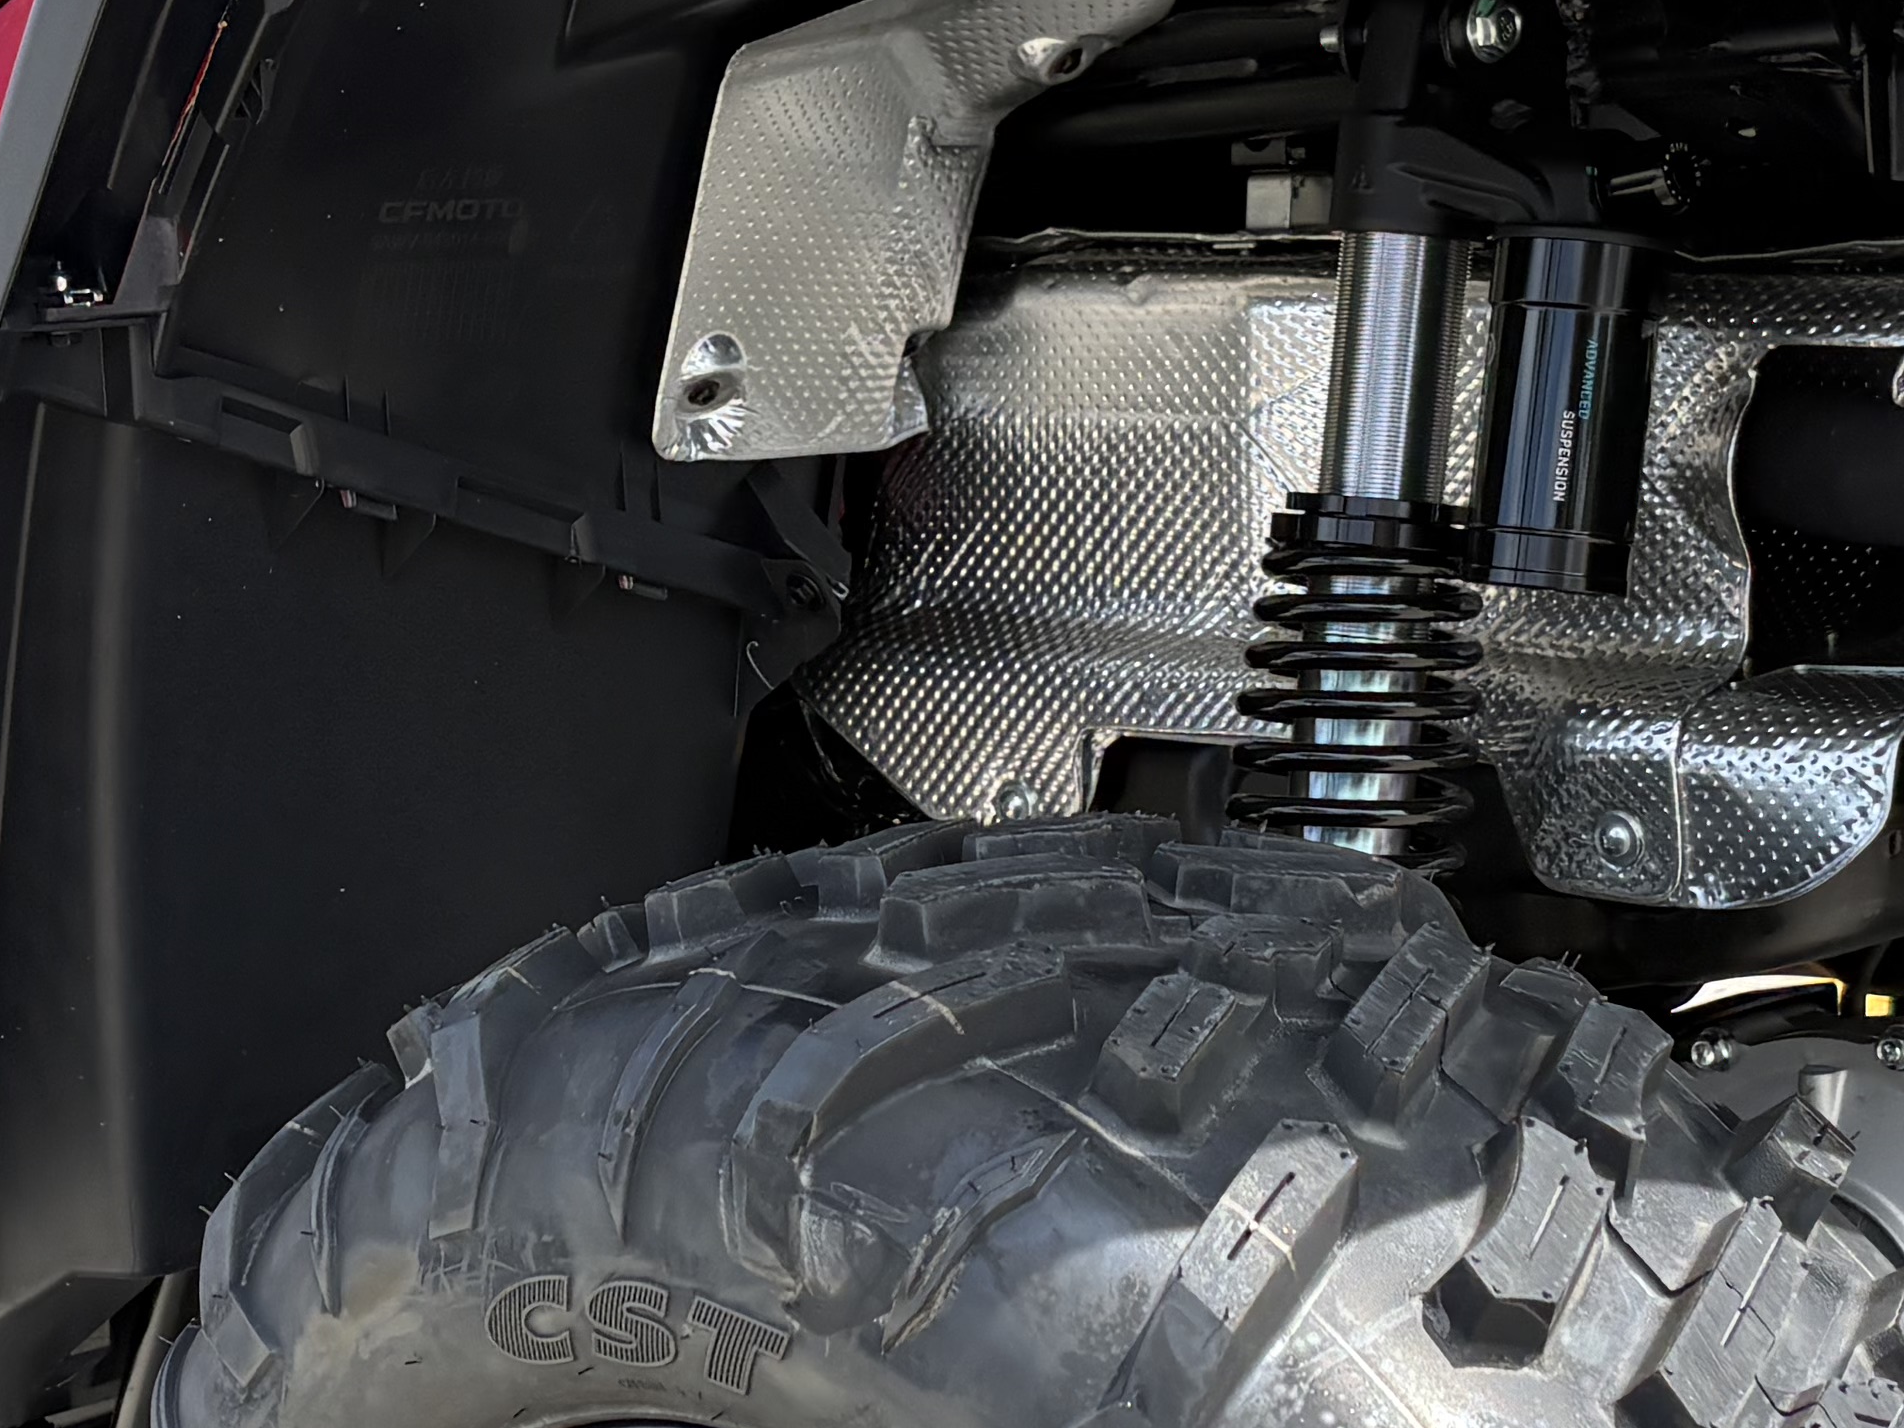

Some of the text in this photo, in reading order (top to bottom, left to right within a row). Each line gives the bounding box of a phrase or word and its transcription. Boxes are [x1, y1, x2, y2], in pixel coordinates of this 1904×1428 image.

[378, 197, 526, 225] CFMOTO
[1579, 339, 1599, 420] ADVANCED
[1553, 410, 1576, 502] SUSPENSION
[485, 1275, 792, 1396] CST
